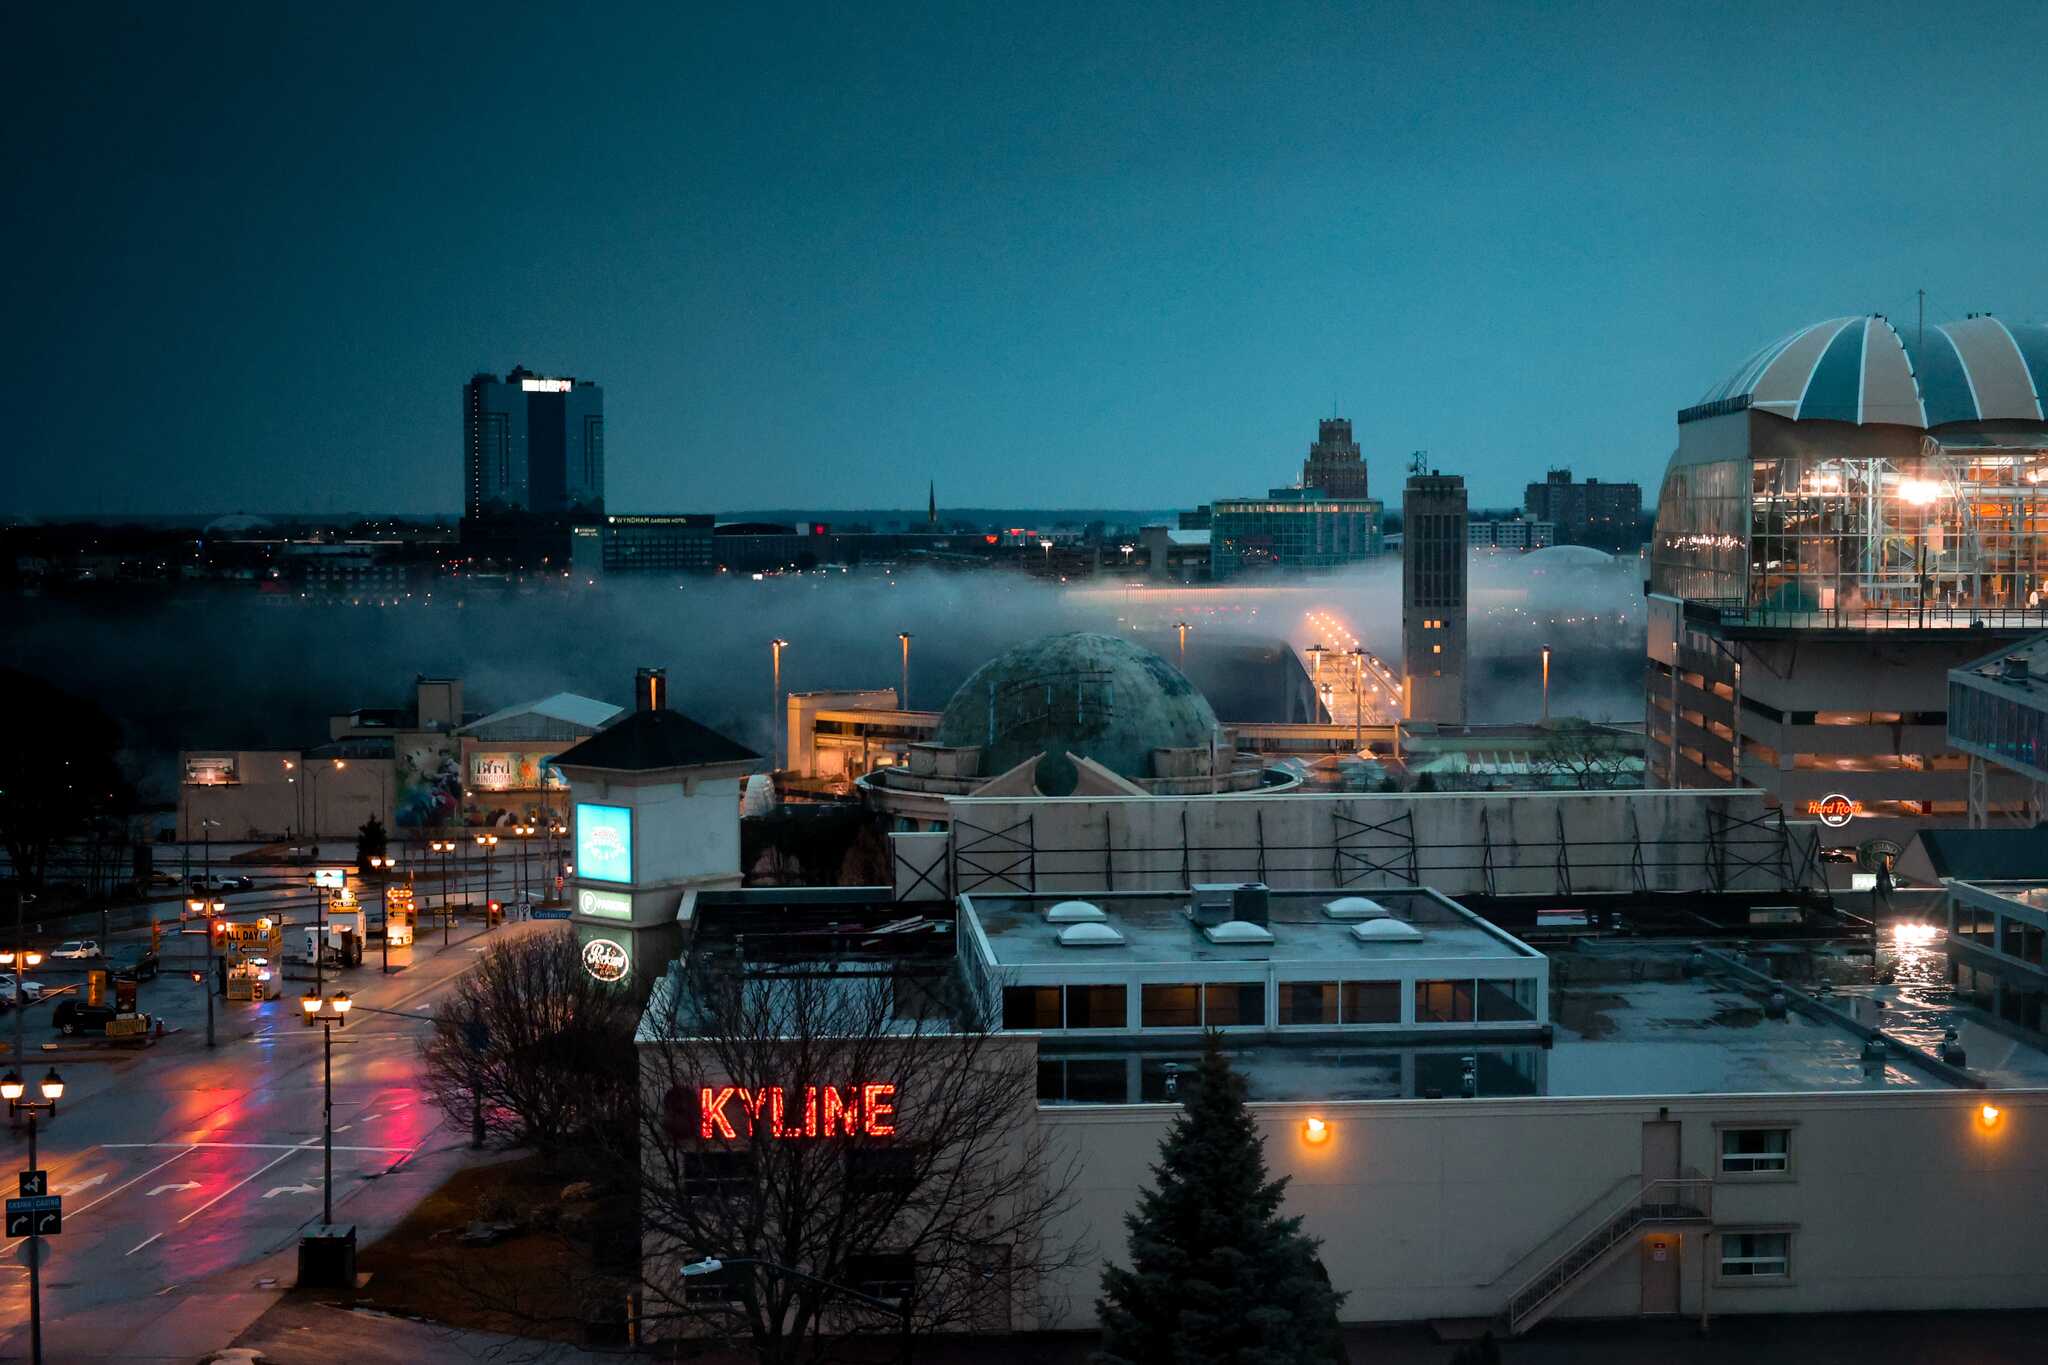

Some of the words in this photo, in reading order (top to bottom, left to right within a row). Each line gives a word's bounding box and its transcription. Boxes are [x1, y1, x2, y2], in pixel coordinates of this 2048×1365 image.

[475, 759, 511, 774] Bird
[1808, 801, 1835, 814] Hard
[1835, 801, 1863, 816] Rock
[227, 931, 240, 941] ALL
[243, 930, 259, 941] DAY
